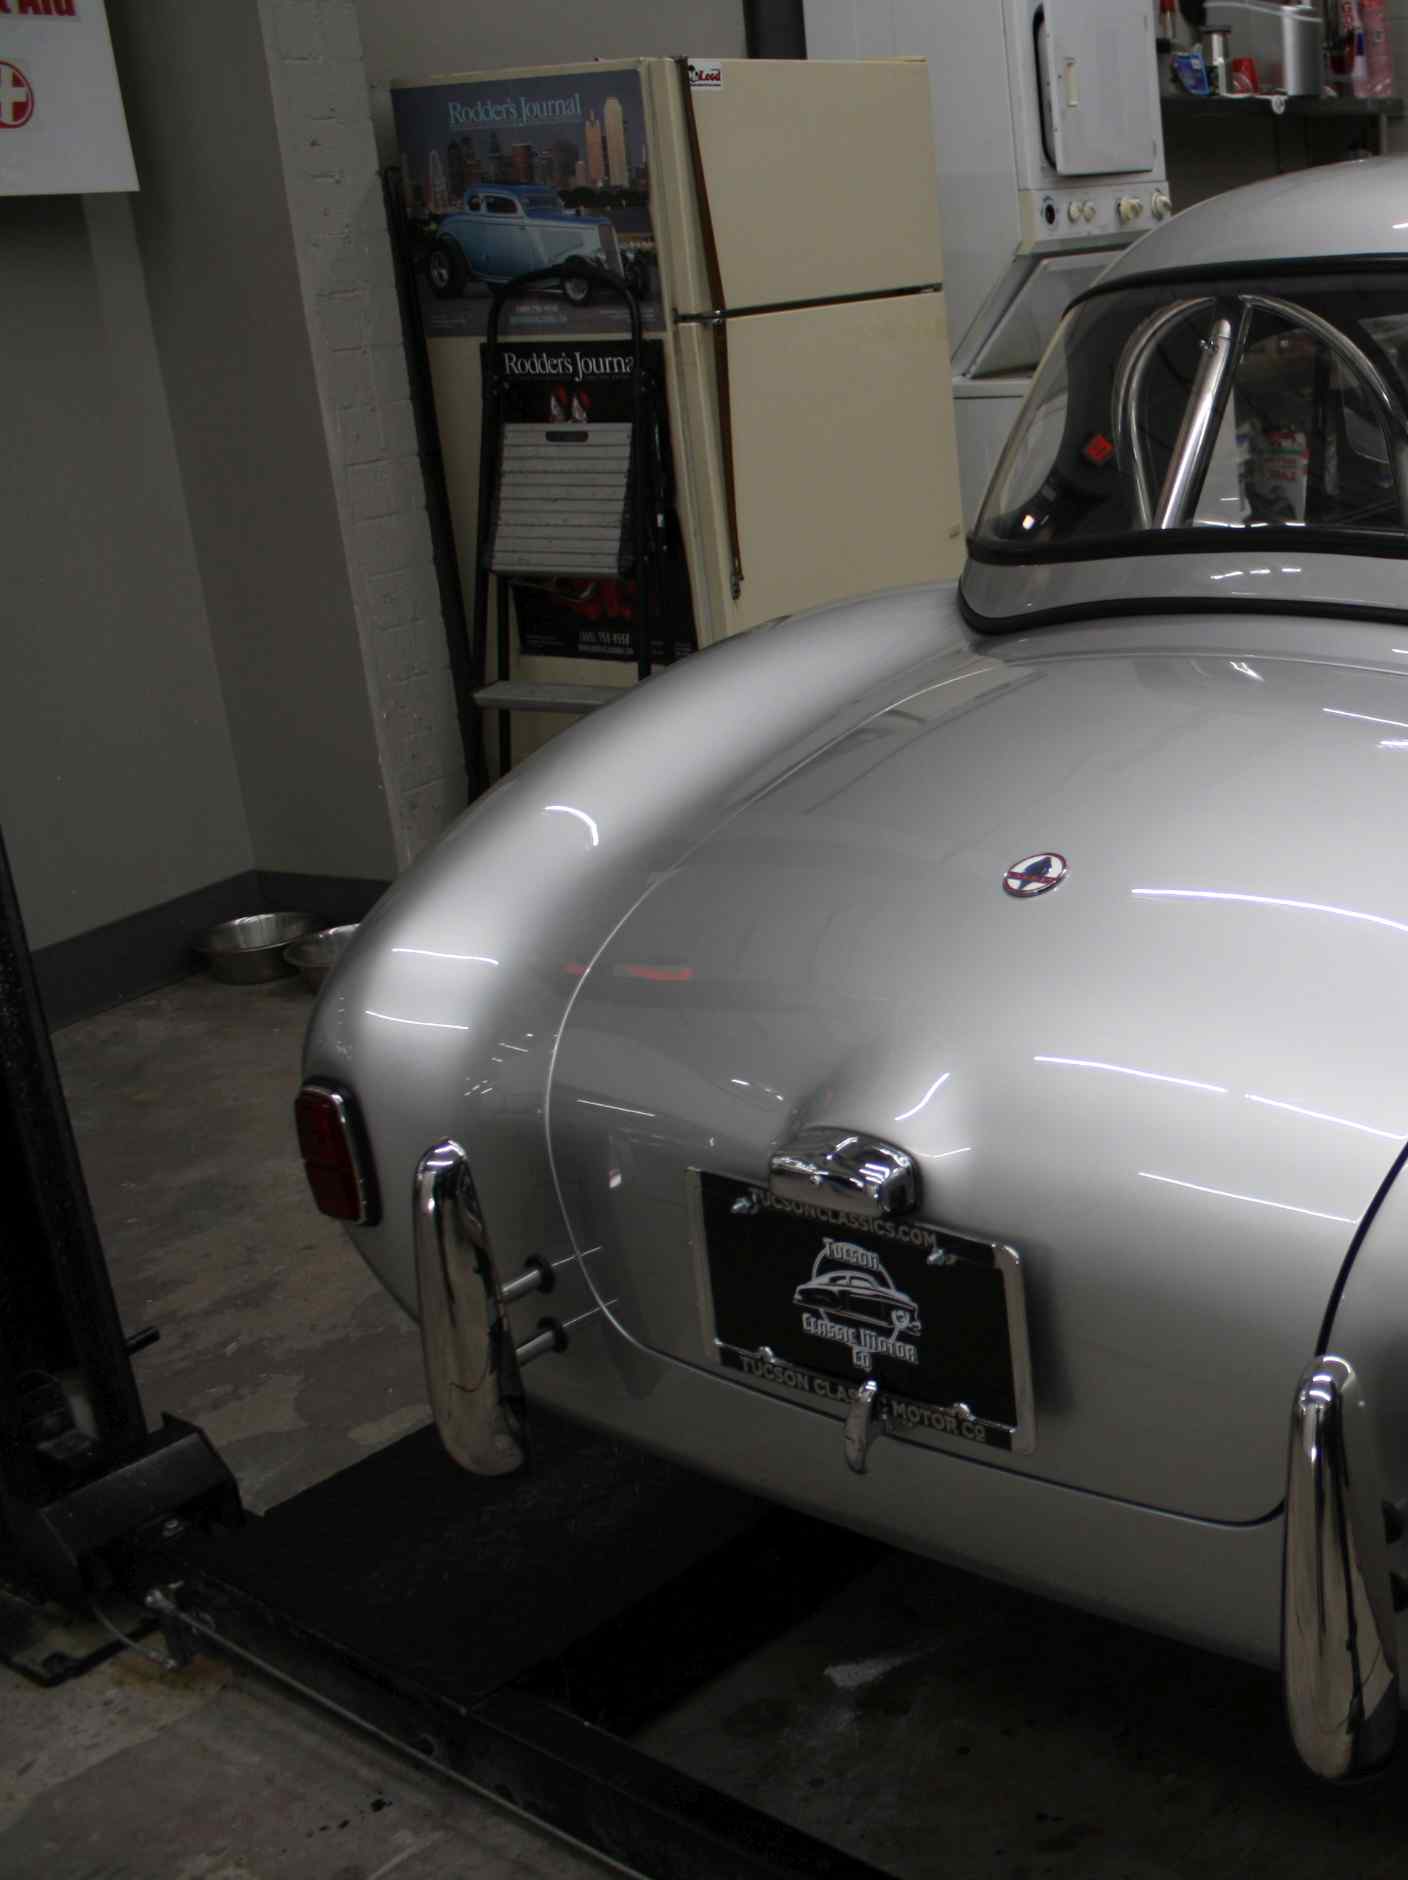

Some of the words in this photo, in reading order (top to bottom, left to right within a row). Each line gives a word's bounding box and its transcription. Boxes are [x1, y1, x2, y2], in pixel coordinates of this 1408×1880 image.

[448, 98, 516, 124] Rodder's
[520, 93, 581, 128] Journal
[503, 352, 573, 375] Rodder's
[574, 352, 634, 382] Journa
[749, 1188, 937, 1249] TUCSONCLASSICS.COM
[740, 1356, 810, 1391] TUCSON
[891, 1400, 960, 1435] MOTOR
